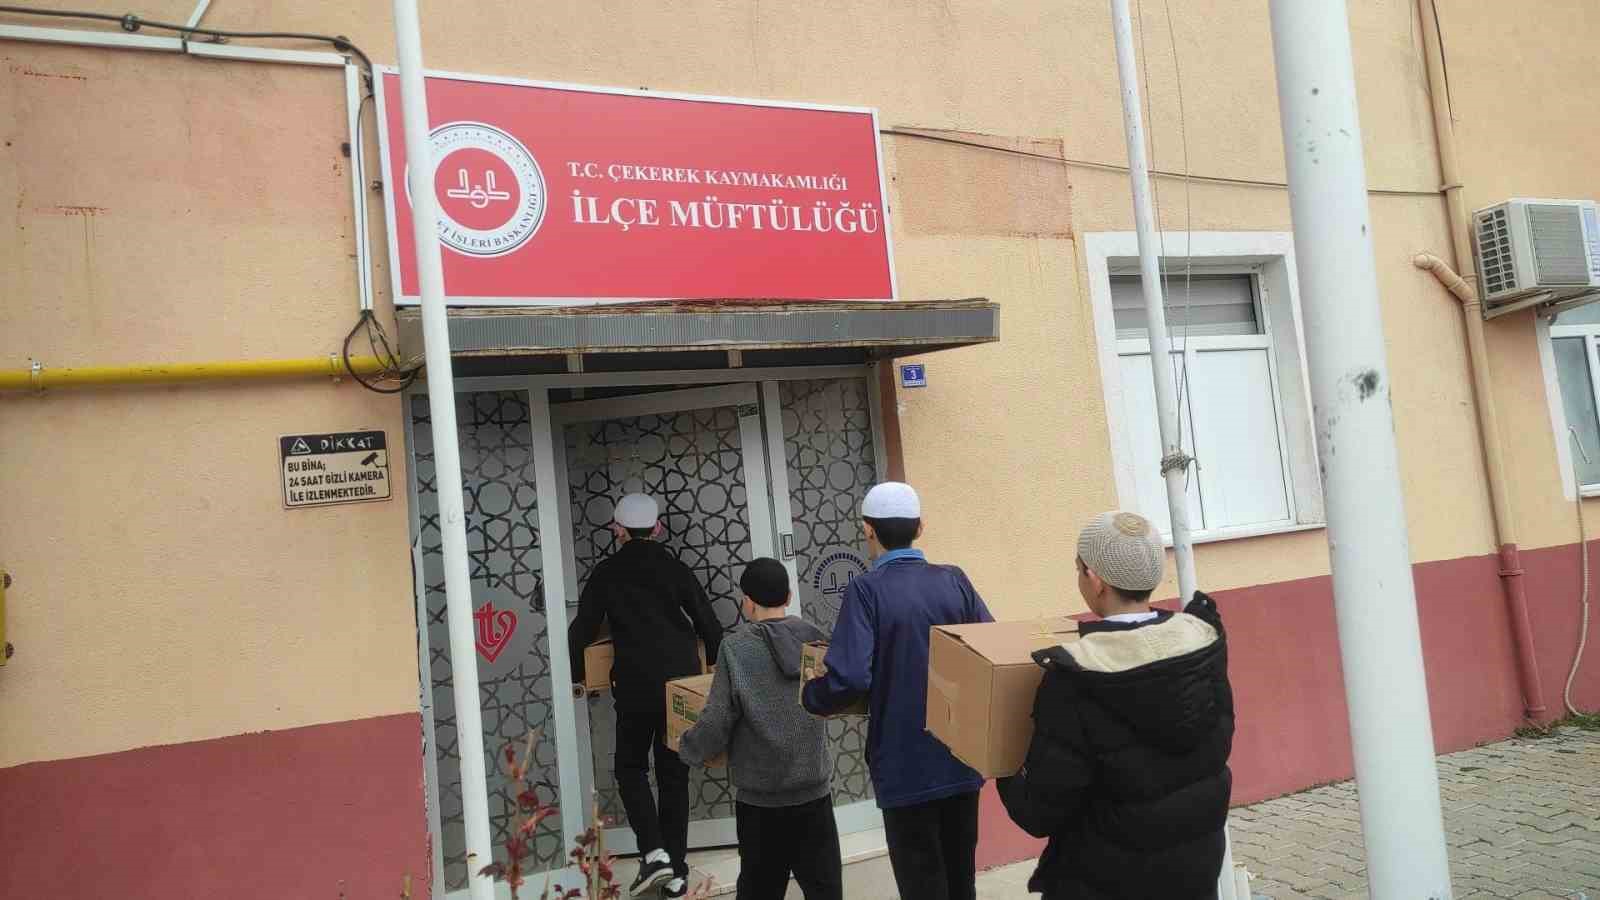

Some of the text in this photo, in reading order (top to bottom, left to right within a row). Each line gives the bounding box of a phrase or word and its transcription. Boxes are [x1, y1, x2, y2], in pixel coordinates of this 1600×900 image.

[567, 162, 848, 192] T.C. ÇEKEREK KAYMAKAMLIĞI
[570, 189, 879, 234] İLÇE MÜFTÜLÜĞÜ
[910, 369, 917, 380] 3
[287, 461, 300, 473] BU
[289, 469, 384, 488] 24 SAAT GİZLİ KAMERA
